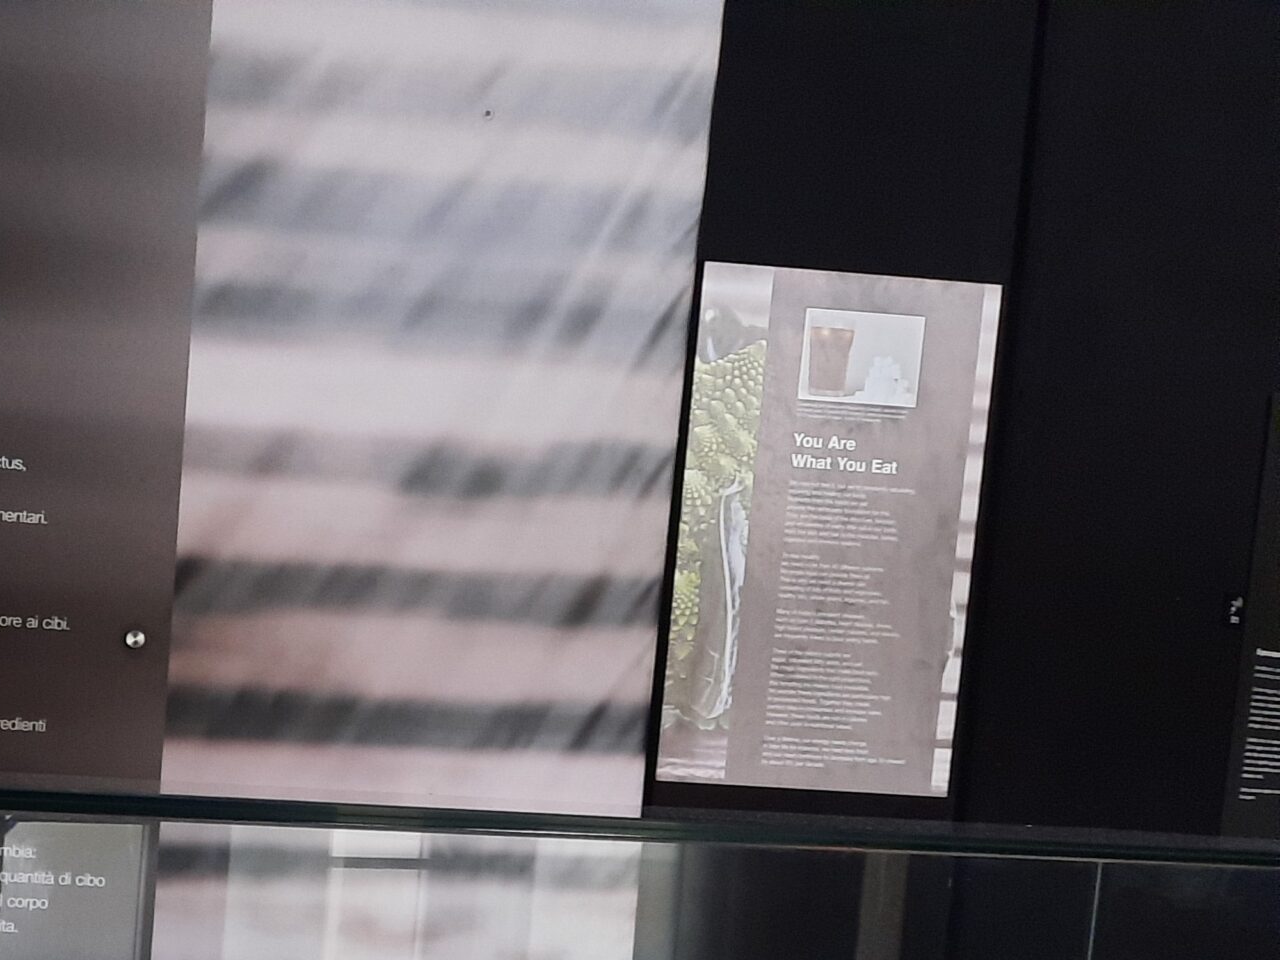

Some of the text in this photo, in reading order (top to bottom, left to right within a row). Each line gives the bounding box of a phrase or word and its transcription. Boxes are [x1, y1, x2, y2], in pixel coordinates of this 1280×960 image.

[793, 432, 857, 450] You Are
[790, 453, 898, 474] What You Eat
